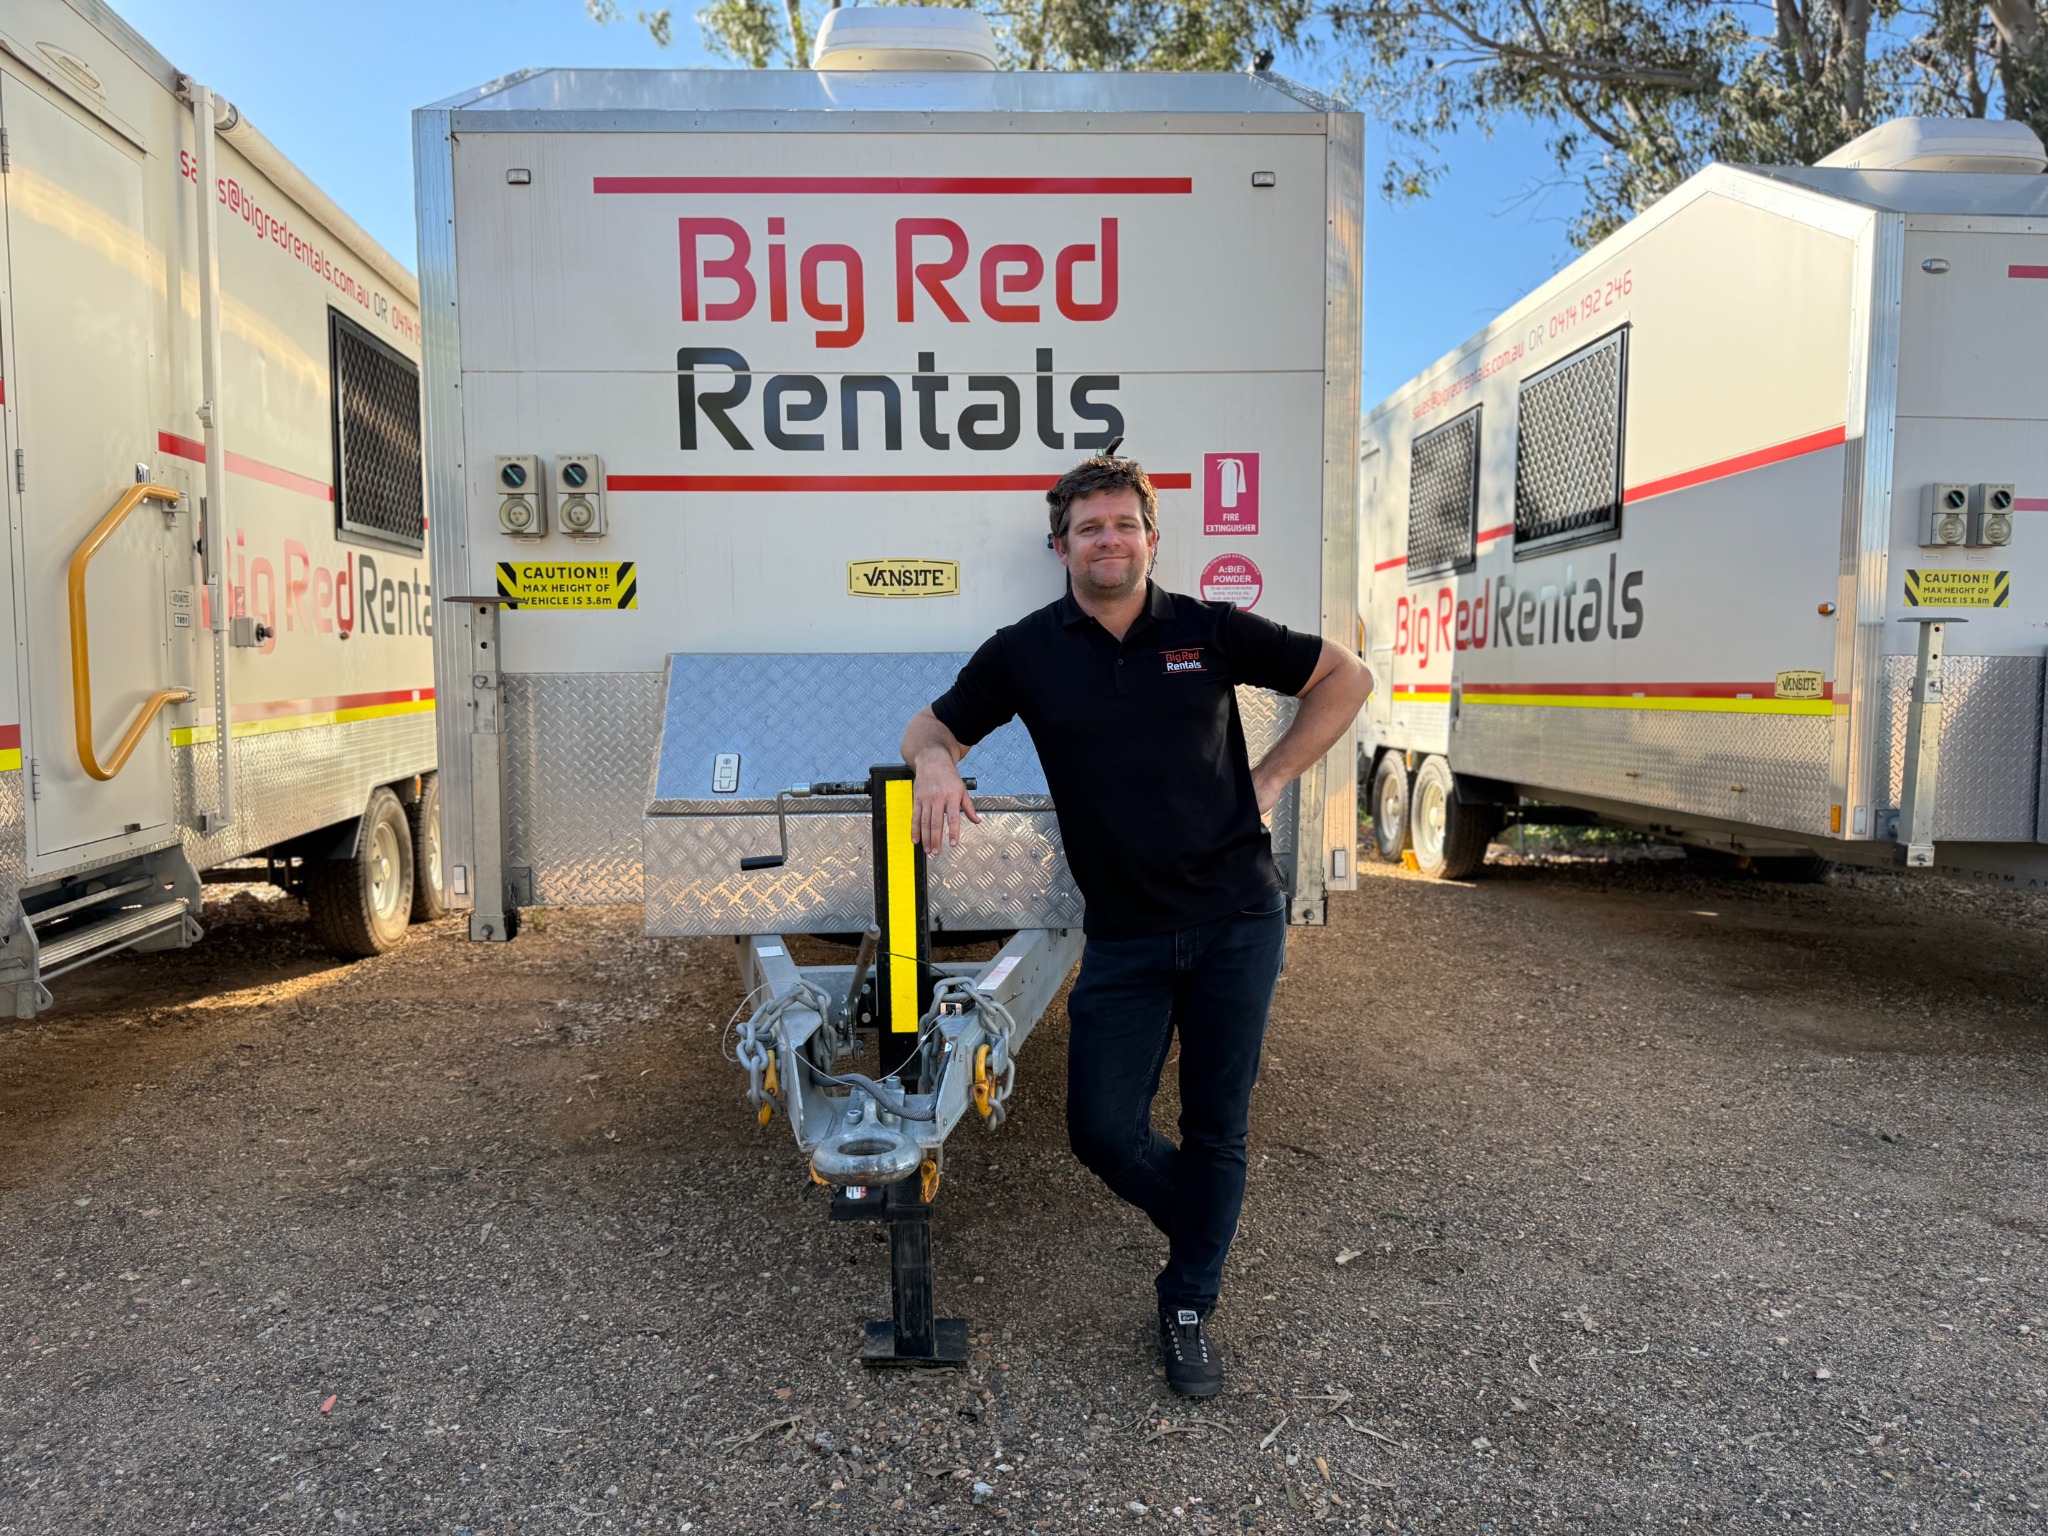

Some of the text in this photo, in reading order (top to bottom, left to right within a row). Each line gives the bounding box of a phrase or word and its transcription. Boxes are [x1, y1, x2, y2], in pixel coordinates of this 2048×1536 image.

[180, 149, 369, 310] sas@bigredrentals.com.au
[374, 292, 388, 324] OR
[392, 306, 413, 341] 0414
[678, 217, 1118, 348] Big Red
[1529, 325, 1544, 351] OR
[1549, 305, 1577, 339] 0414
[1580, 288, 1601, 321] 192
[1605, 269, 1632, 307] 246
[677, 347, 1125, 451] Rentals
[1222, 513, 1240, 521] FIRE
[1205, 524, 1256, 532] EXTINGUISHER
[523, 567, 608, 579] CAUTION!!
[863, 566, 944, 587] VANSITE
[1213, 575, 1252, 583] POWDER
[284, 539, 354, 633] Red
[523, 584, 611, 592] MAX HEIGHT OF
[523, 597, 612, 605] VEHICLE IS 3.8m
[1395, 552, 1644, 669] Big Red Rentals
[1165, 650, 1199, 662] Big Red
[1166, 660, 1202, 671] Rentals
[1781, 675, 1817, 691] VANSITE
